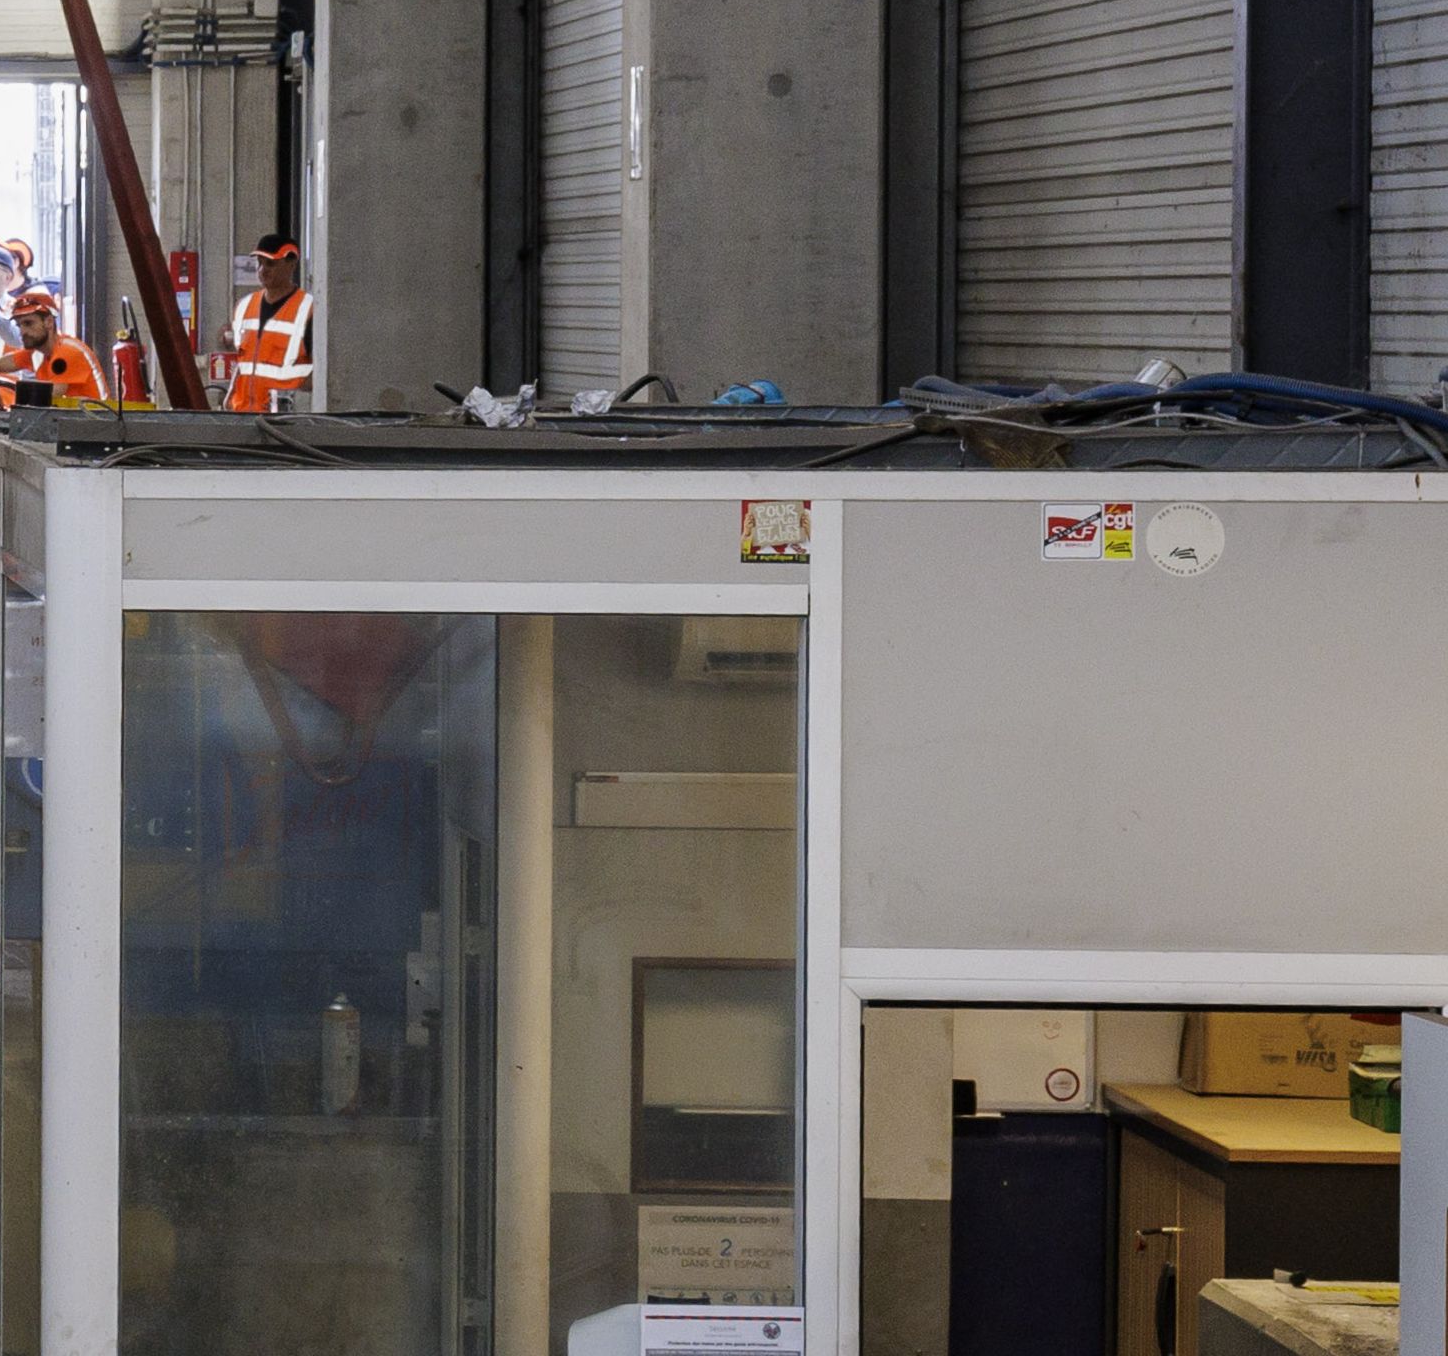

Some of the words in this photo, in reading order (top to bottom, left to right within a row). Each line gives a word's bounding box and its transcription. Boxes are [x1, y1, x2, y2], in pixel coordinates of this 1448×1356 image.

[755, 504, 798, 518] POUR
[1104, 511, 1133, 530] cgt
[672, 1214, 737, 1225] CORONAVIRUS
[719, 1238, 733, 1257] 2
[680, 1259, 709, 1269] DANS
[712, 1259, 732, 1269] CET
[734, 1260, 771, 1270] ESPACE
